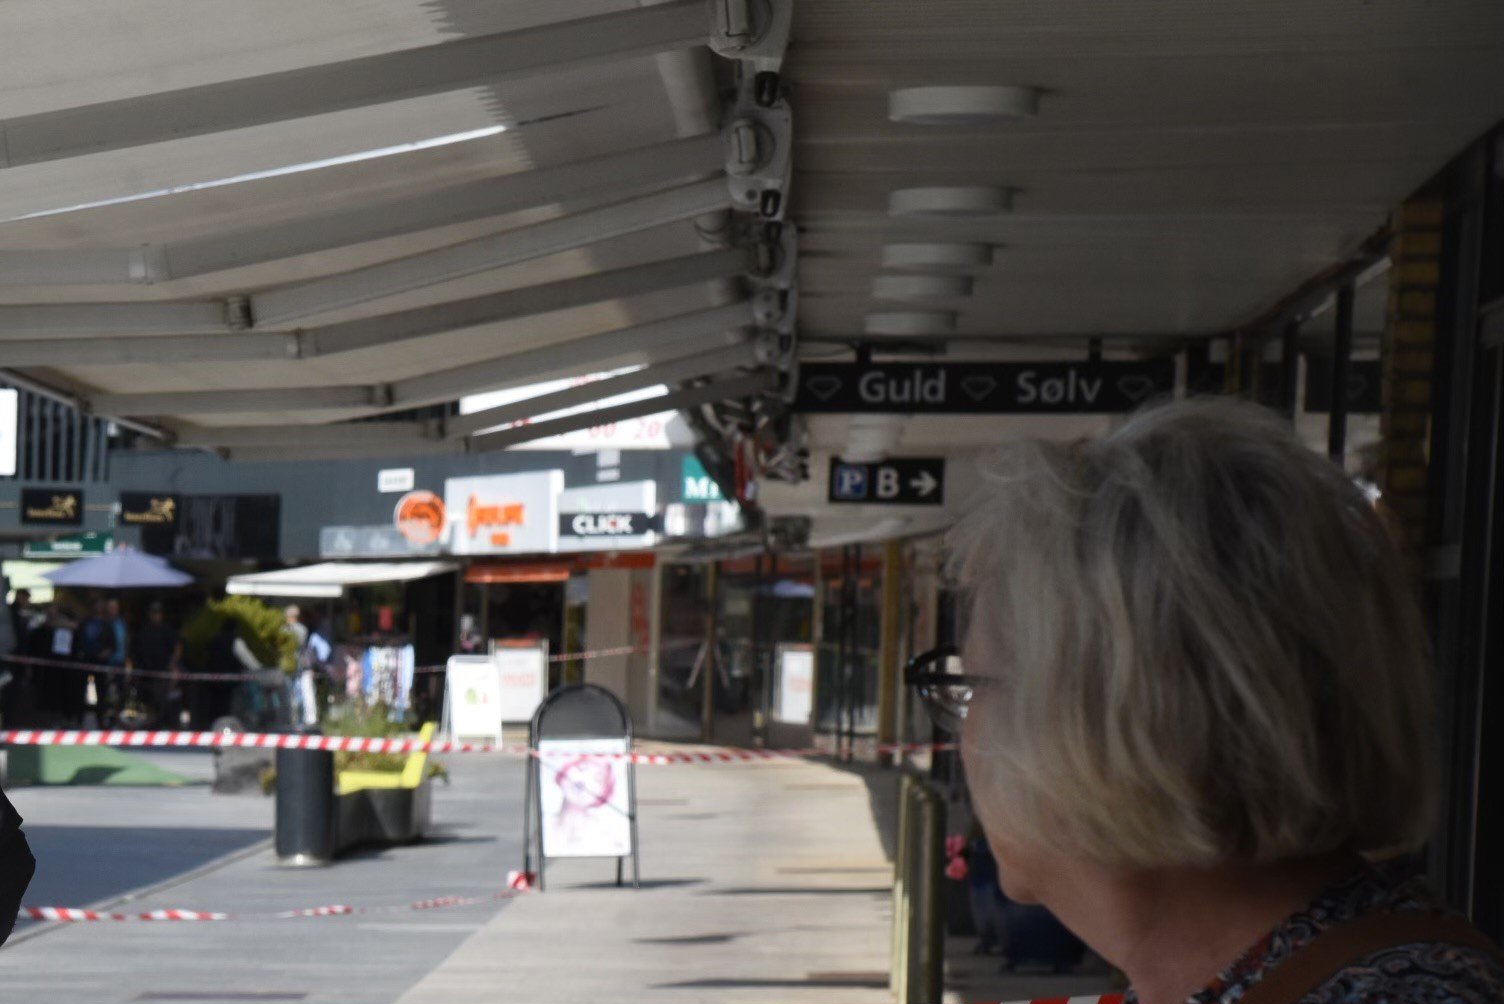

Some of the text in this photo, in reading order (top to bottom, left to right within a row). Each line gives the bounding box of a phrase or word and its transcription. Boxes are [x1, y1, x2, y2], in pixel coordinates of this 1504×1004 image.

[858, 369, 1101, 402] Guld Sølv
[876, 468, 899, 497] B
[572, 514, 634, 534] CLICK
